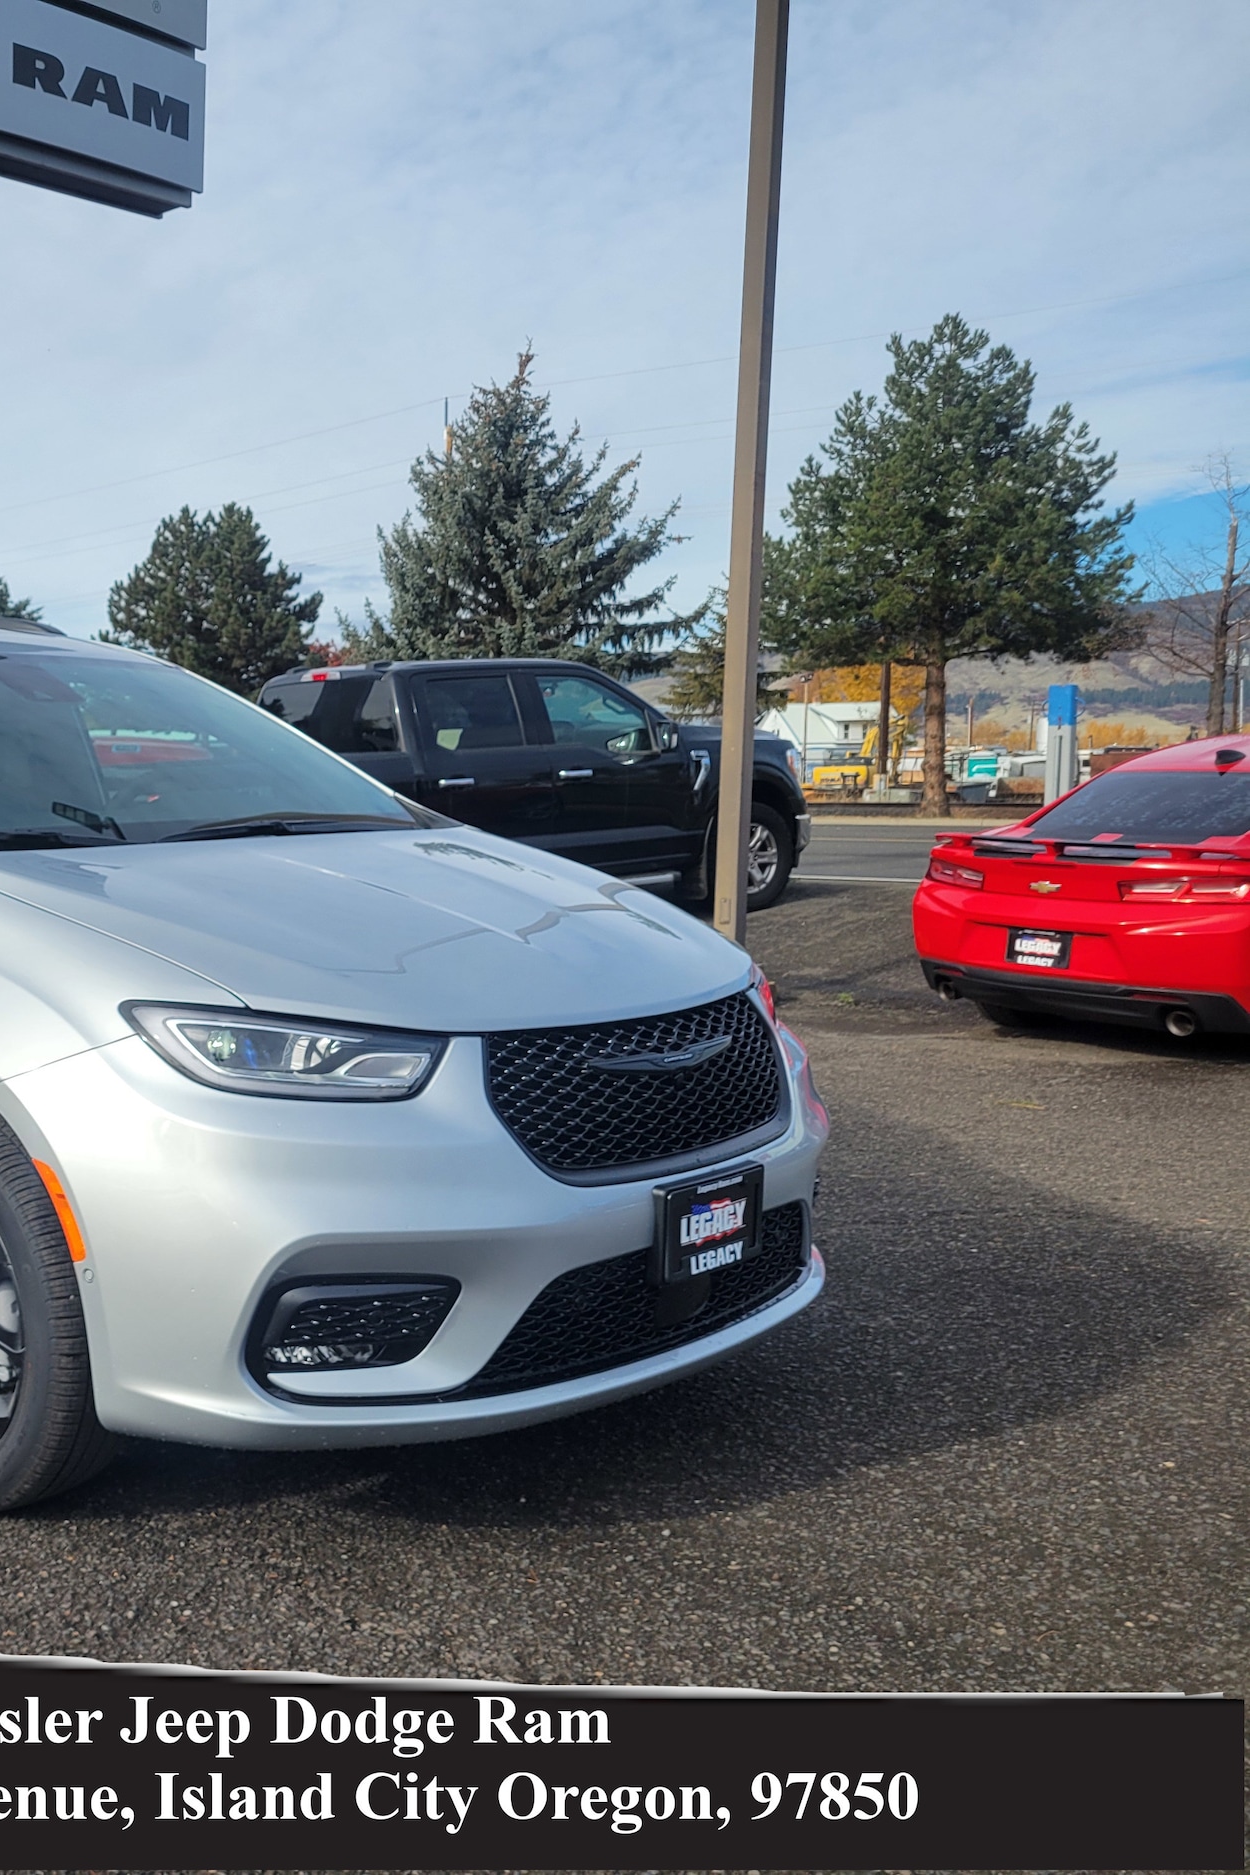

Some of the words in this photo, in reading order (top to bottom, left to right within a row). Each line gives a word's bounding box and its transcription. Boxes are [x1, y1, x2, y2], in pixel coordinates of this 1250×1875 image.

[12, 42, 190, 142] RAM
[680, 1199, 747, 1244] LEGACY
[690, 1241, 744, 1275] LEGACY
